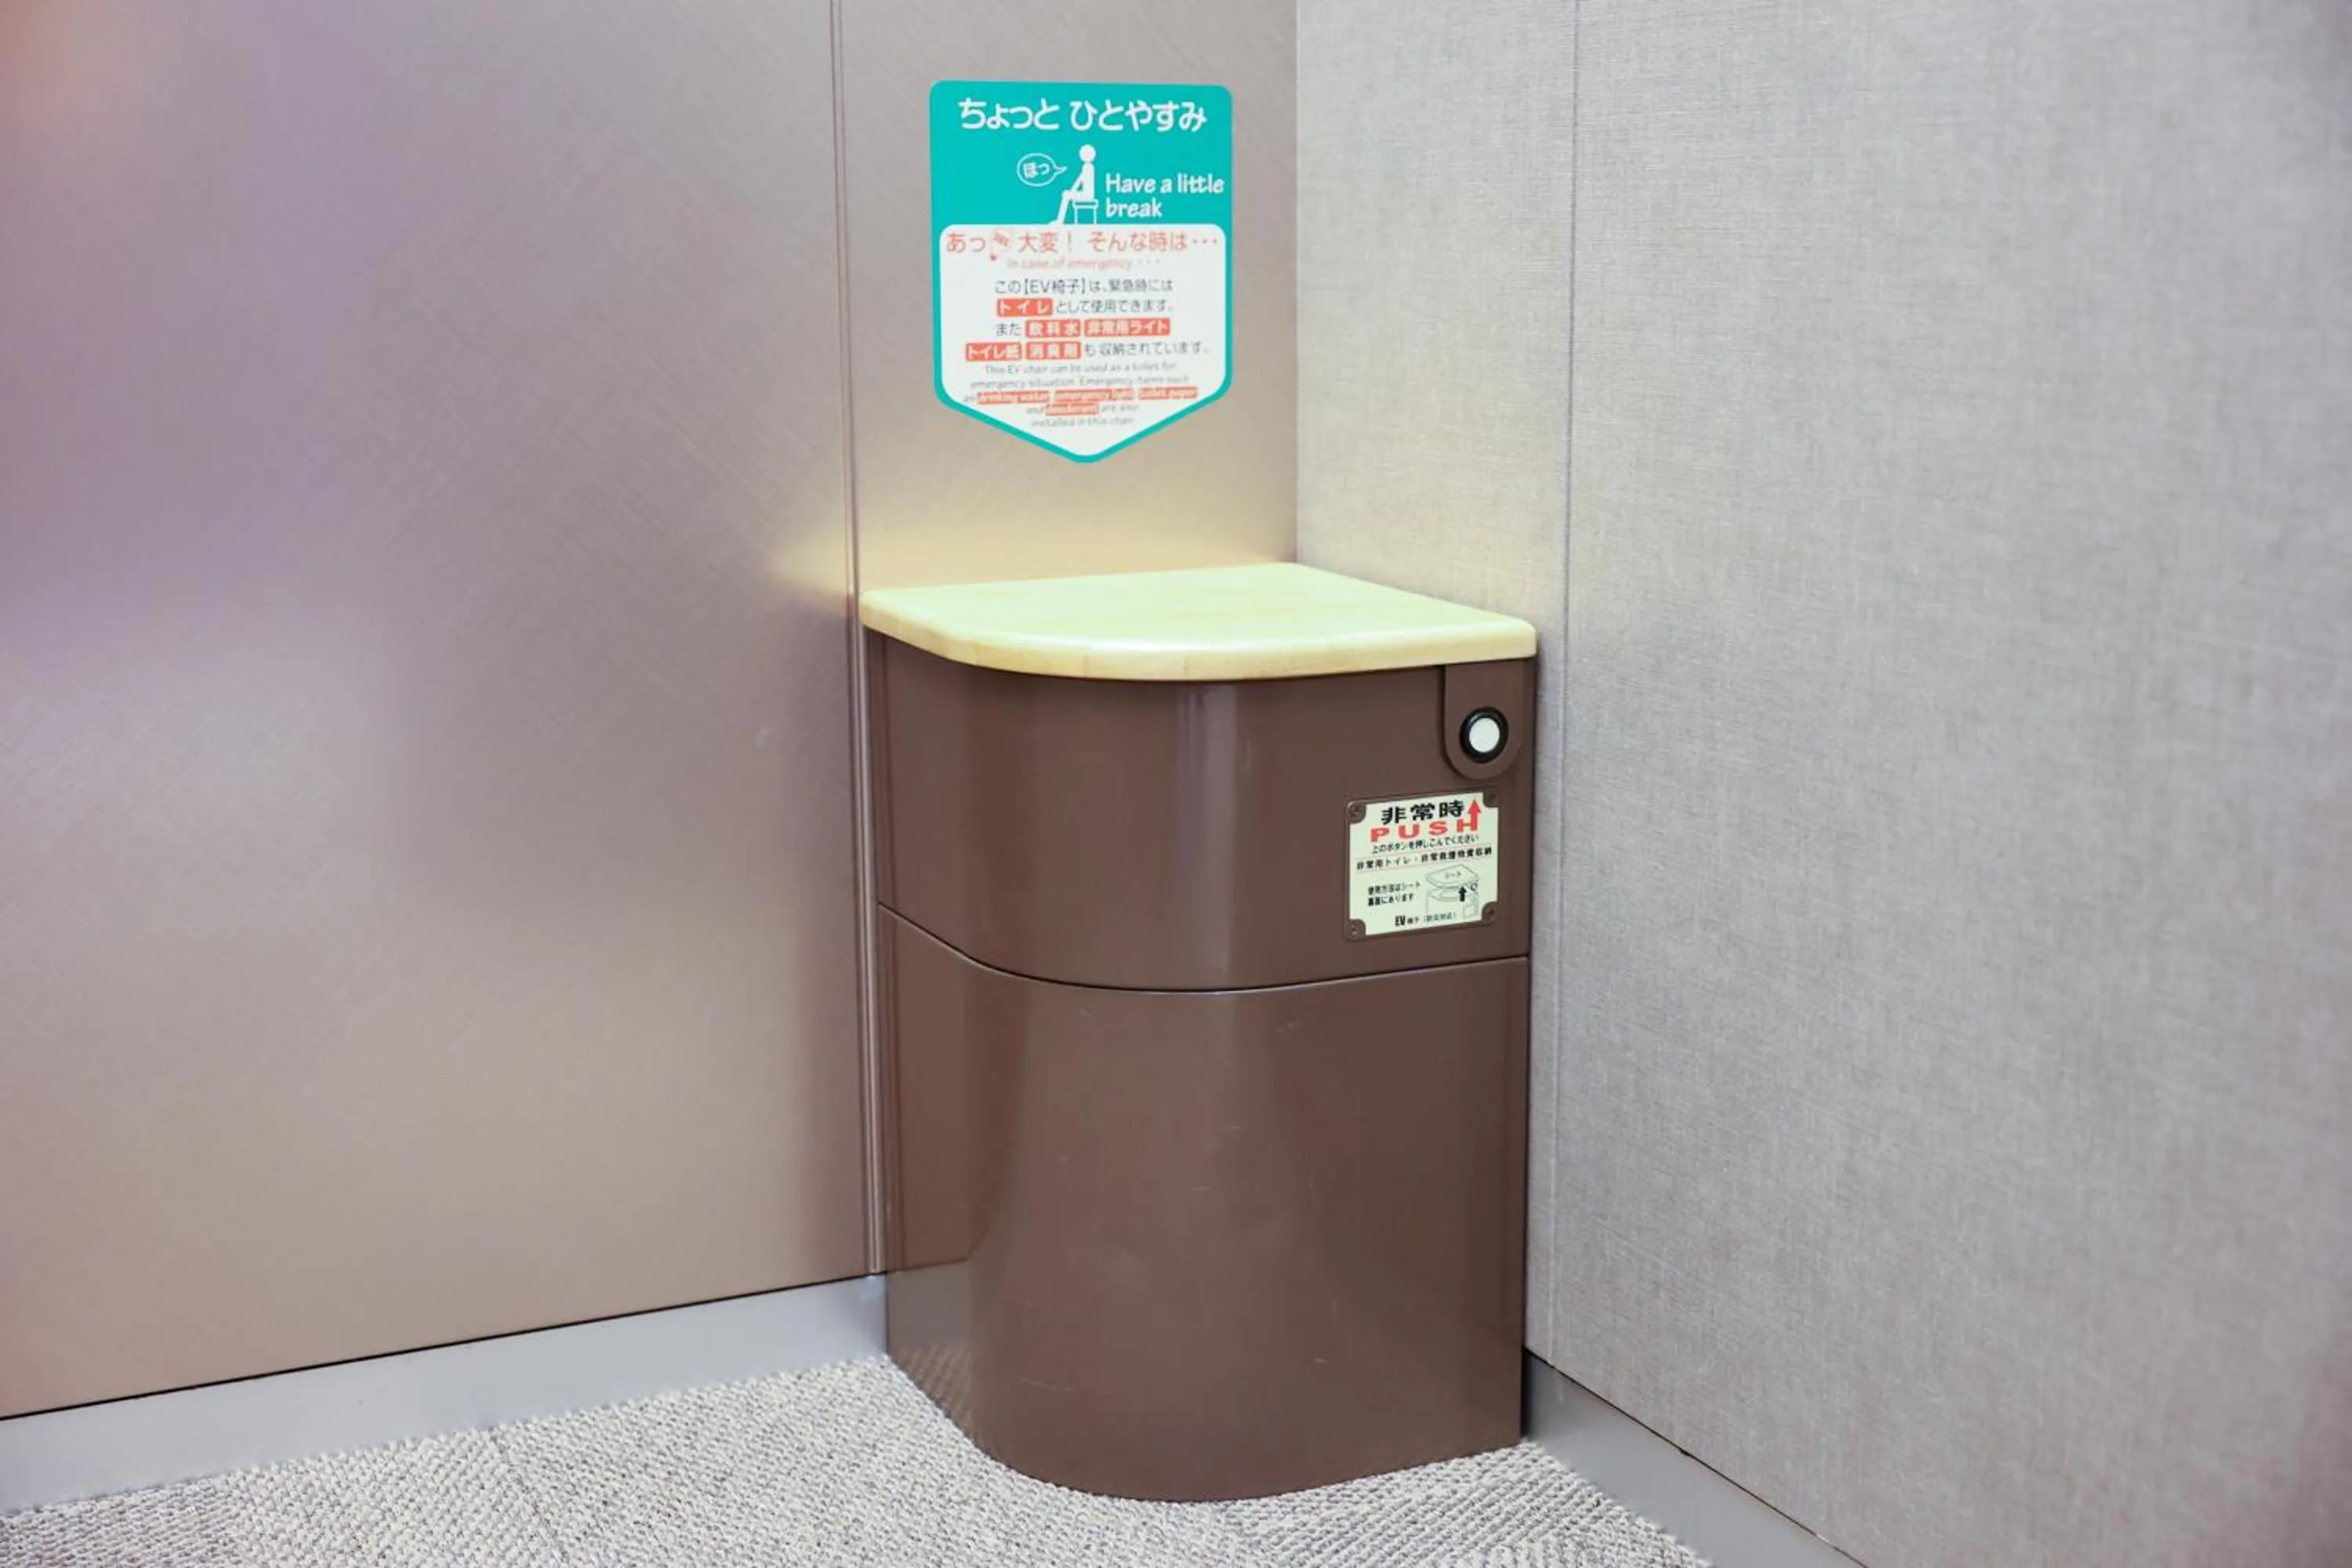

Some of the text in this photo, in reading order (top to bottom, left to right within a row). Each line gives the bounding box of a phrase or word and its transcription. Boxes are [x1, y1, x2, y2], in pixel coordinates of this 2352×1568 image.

[958, 97, 1207, 132] ちょっと ひとやすみ
[1022, 162, 1051, 180] ほっ
[1105, 172, 1225, 194] Have a little
[1105, 198, 1163, 219] break
[946, 233, 986, 253] あっ
[999, 301, 1051, 315] トイレ
[996, 321, 1021, 337] また
[1381, 800, 1465, 826] 非常時
[1370, 818, 1479, 843] PUSH
[1395, 915, 1406, 927] EV
